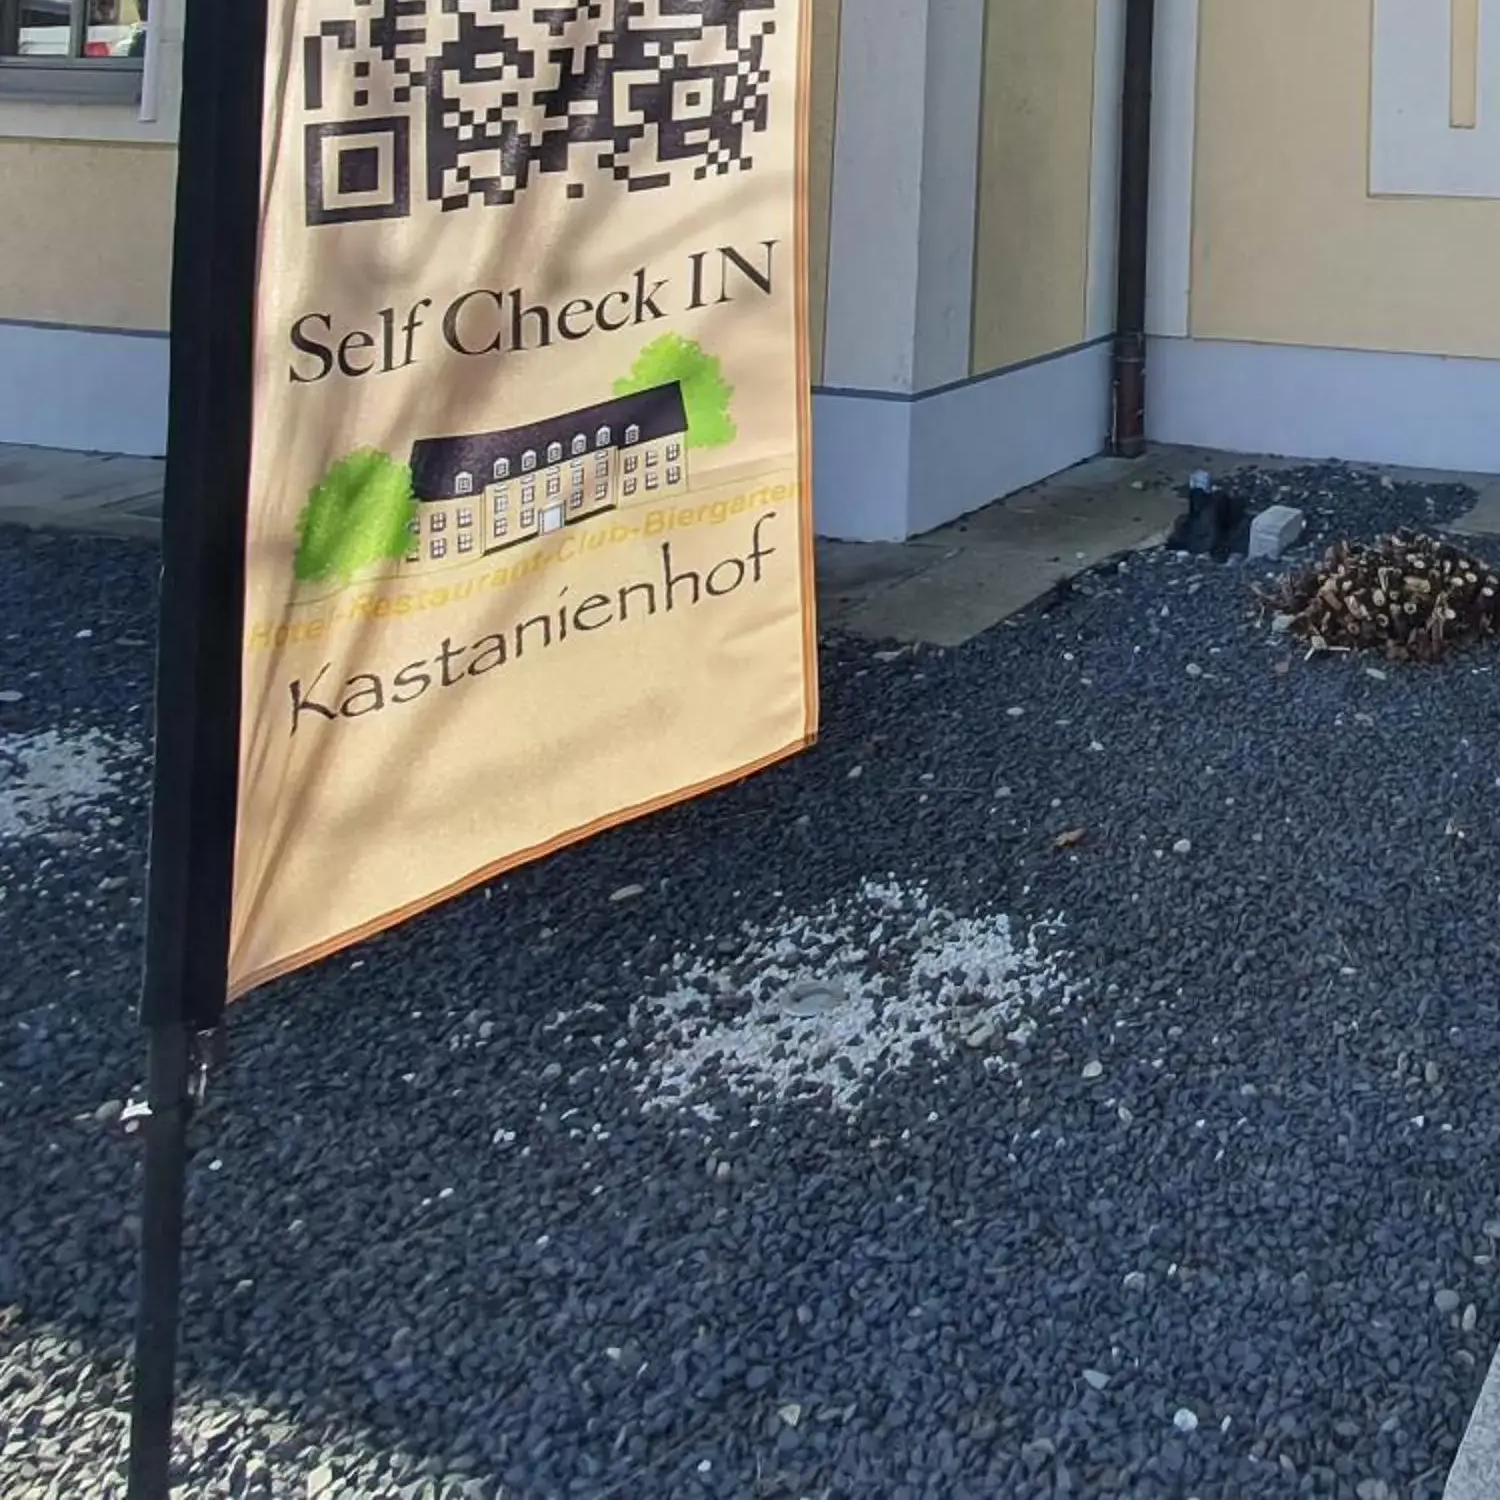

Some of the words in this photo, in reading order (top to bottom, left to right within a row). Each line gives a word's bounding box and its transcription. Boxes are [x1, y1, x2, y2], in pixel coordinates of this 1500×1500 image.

[288, 297, 432, 383] Self
[441, 267, 670, 356] Check
[684, 238, 780, 311] IN
[288, 511, 778, 738] Kastanienhof
